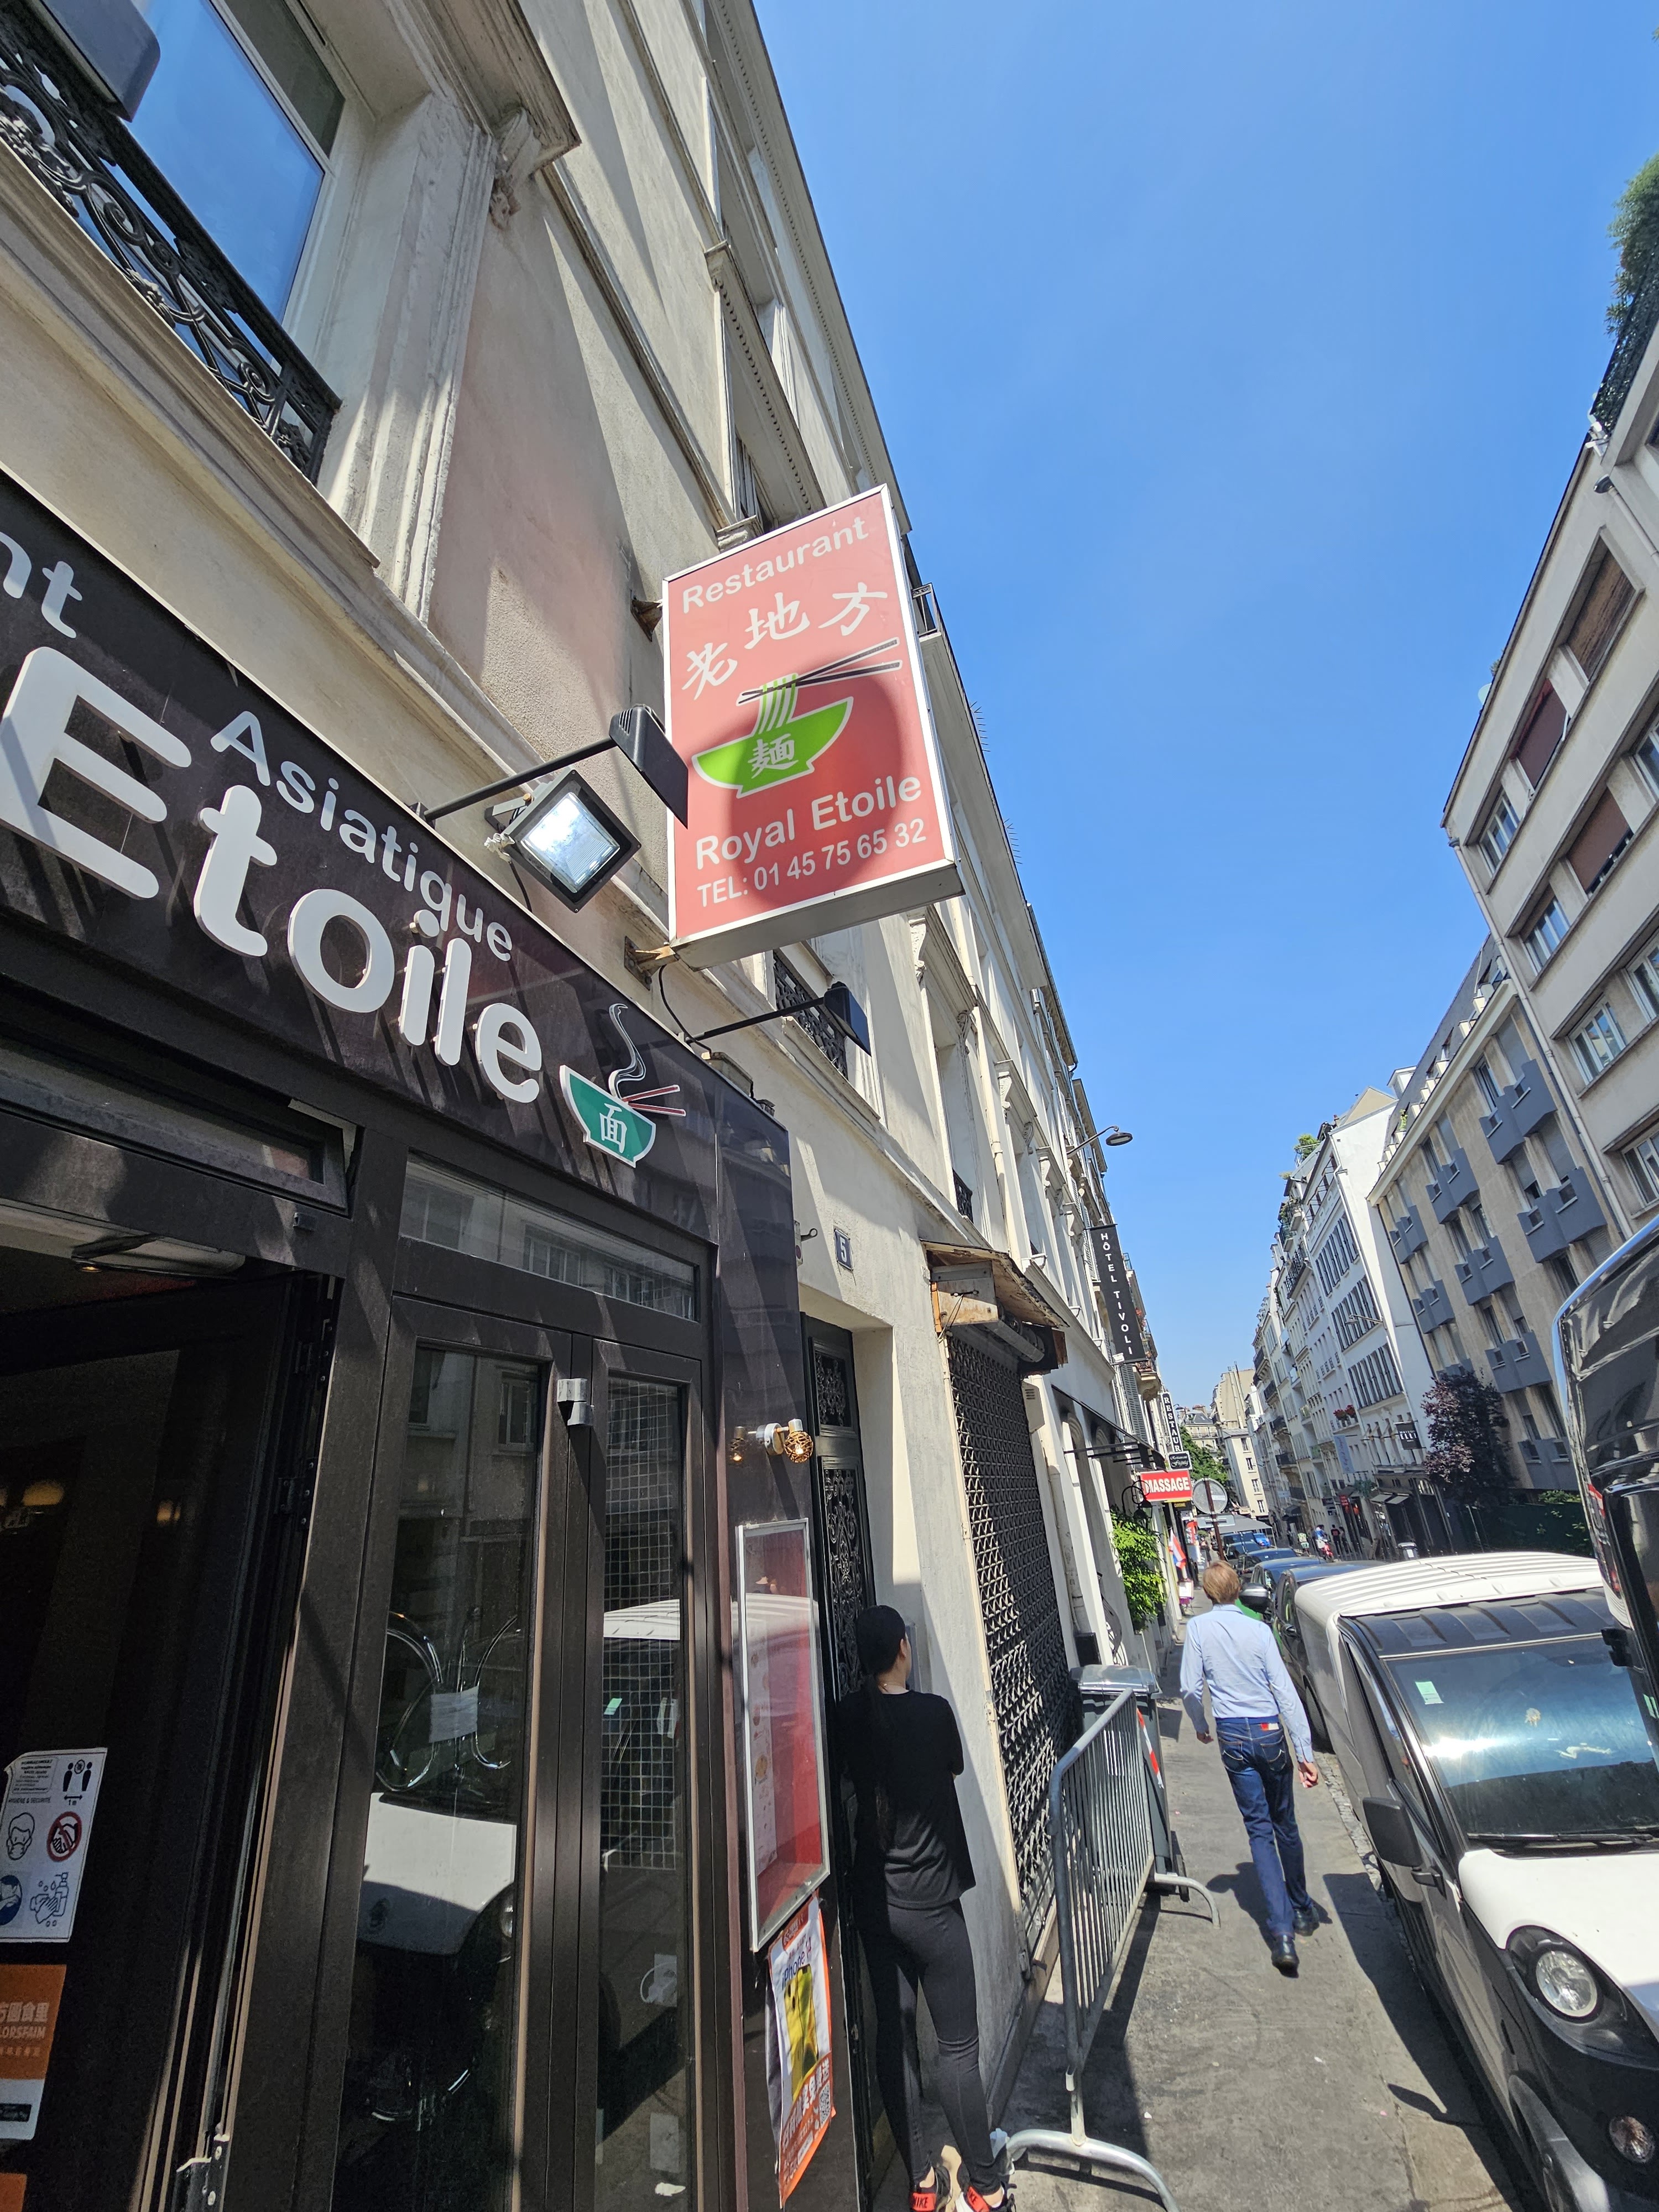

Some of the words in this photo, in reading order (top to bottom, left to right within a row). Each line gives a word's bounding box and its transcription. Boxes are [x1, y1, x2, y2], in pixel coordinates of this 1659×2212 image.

[682, 517, 868, 614] Restaurant
[682, 582, 888, 700] 老地方
[210, 711, 512, 961] Asiatique
[696, 808, 795, 870] Royal
[812, 775, 922, 832] Etoile
[697, 875, 749, 907] TEL:
[754, 865, 778, 890] 01
[787, 859, 816, 881] 45
[822, 844, 851, 867] 75
[857, 832, 887, 854] 65
[895, 818, 927, 847] 32
[0, 646, 542, 1103] Etoile
[599, 1103, 628, 1153] 面
[839, 1237, 847, 1262] 5
[1100, 1233, 1117, 1282] HÔTEL
[1113, 1291, 1133, 1355] TIVOLI
[1145, 1477, 1190, 1493] MASSAGE
[1185, 1527, 1194, 1545] ZZA
[782, 1951, 805, 1991] iPhone
[806, 1937, 812, 1959] 14
